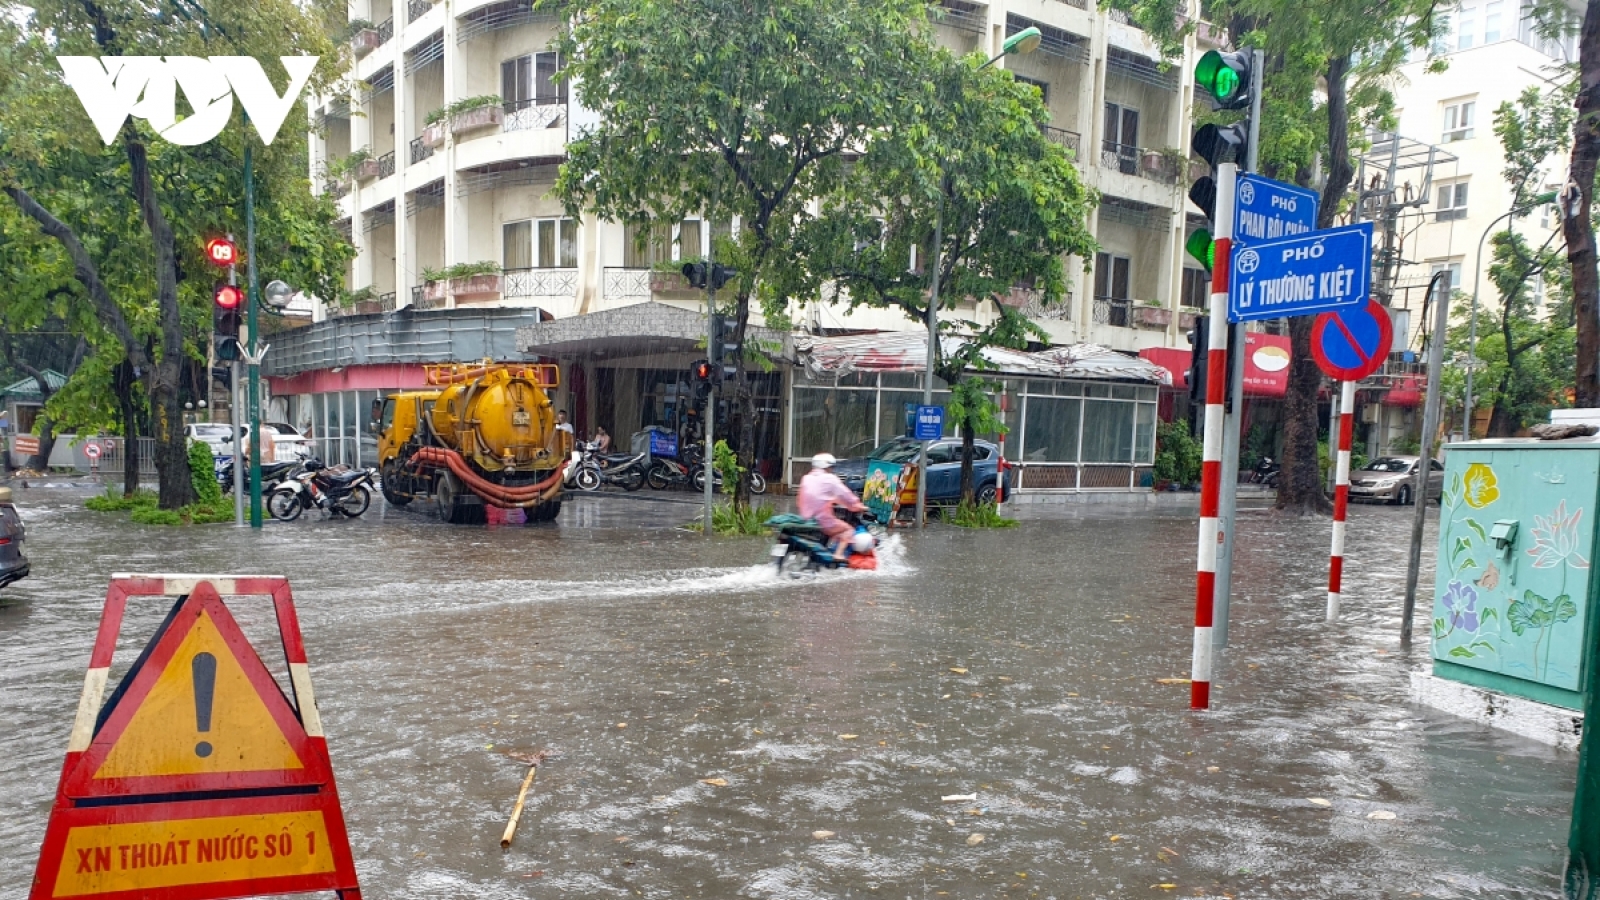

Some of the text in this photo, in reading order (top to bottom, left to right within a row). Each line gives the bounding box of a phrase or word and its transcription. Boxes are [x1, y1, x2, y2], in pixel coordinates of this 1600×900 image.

[1271, 194, 1298, 213] PHỐ
[1239, 209, 1266, 239] PHAN
[213, 244, 232, 260] 09
[1282, 236, 1325, 263] PHỐ
[1239, 263, 1355, 308] LÝ THƯỜNG KIỆT
[75, 822, 317, 874] XN THOÁT NƯỚC SỐ 1
